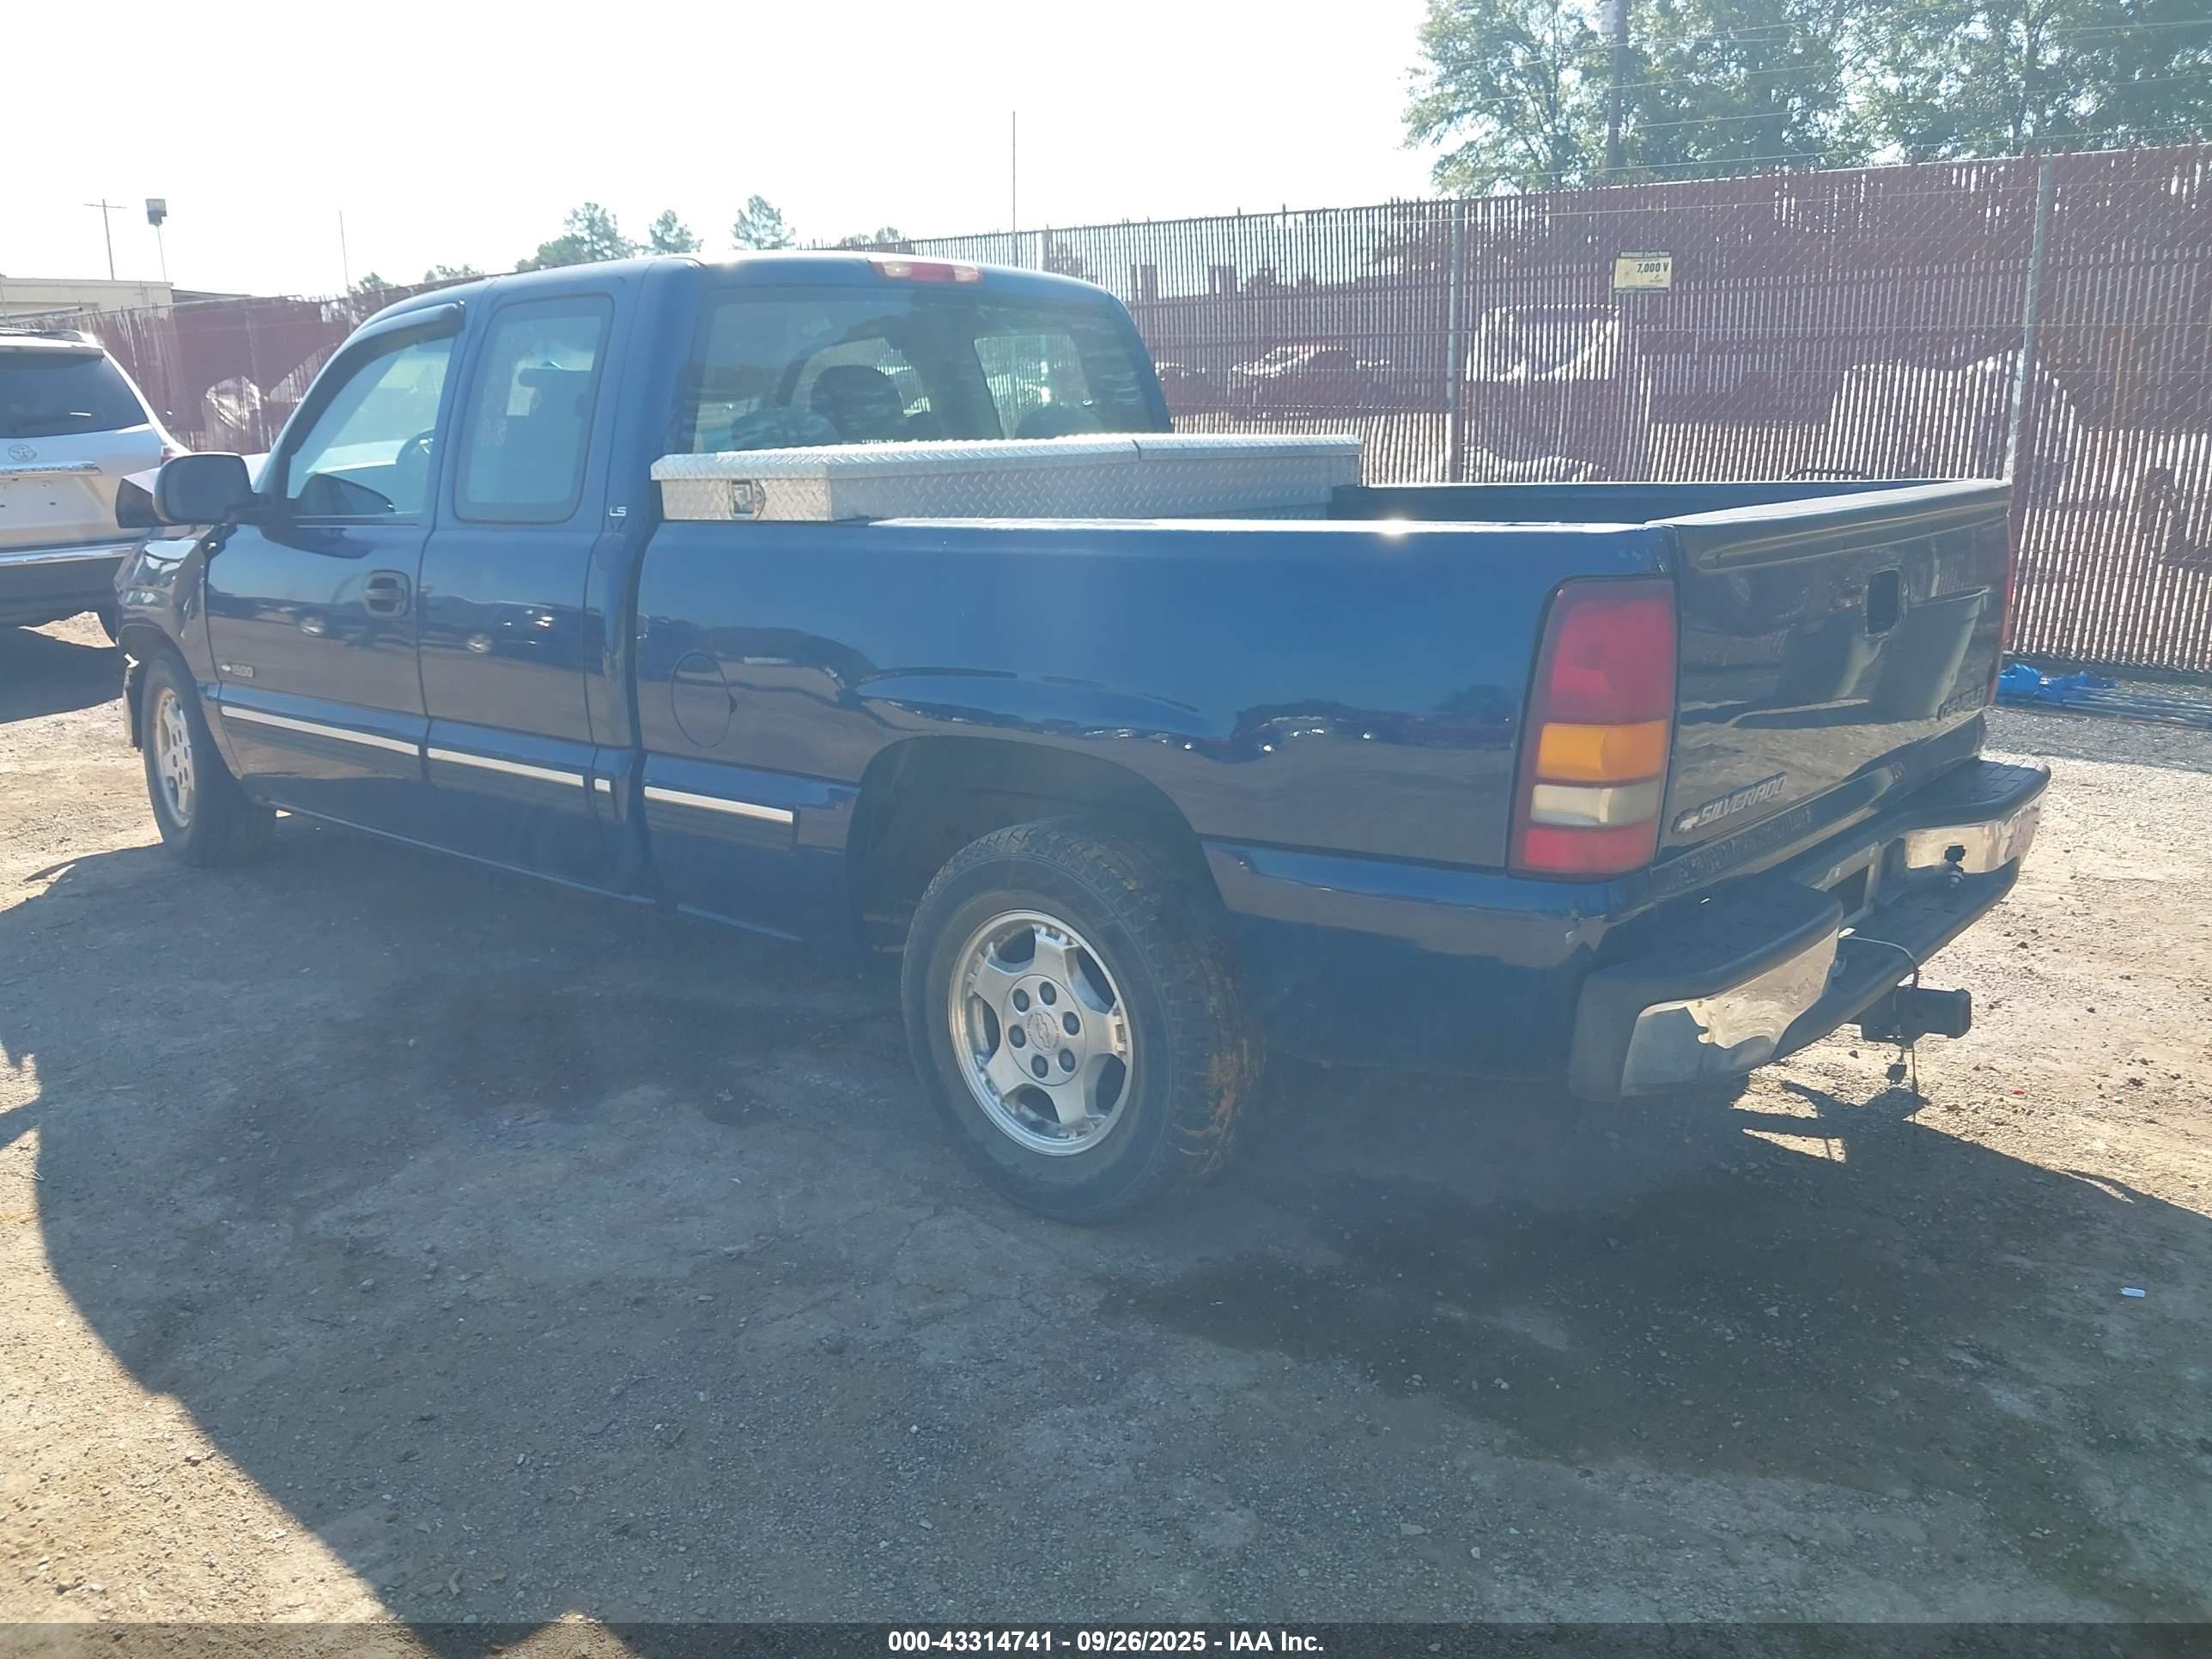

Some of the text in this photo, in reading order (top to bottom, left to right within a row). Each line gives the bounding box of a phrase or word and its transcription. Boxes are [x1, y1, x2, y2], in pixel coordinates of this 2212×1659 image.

[1637, 262, 1669, 274] 7,000 V
[610, 507, 626, 516] LS
[1698, 775, 1787, 827] SILVERADO
